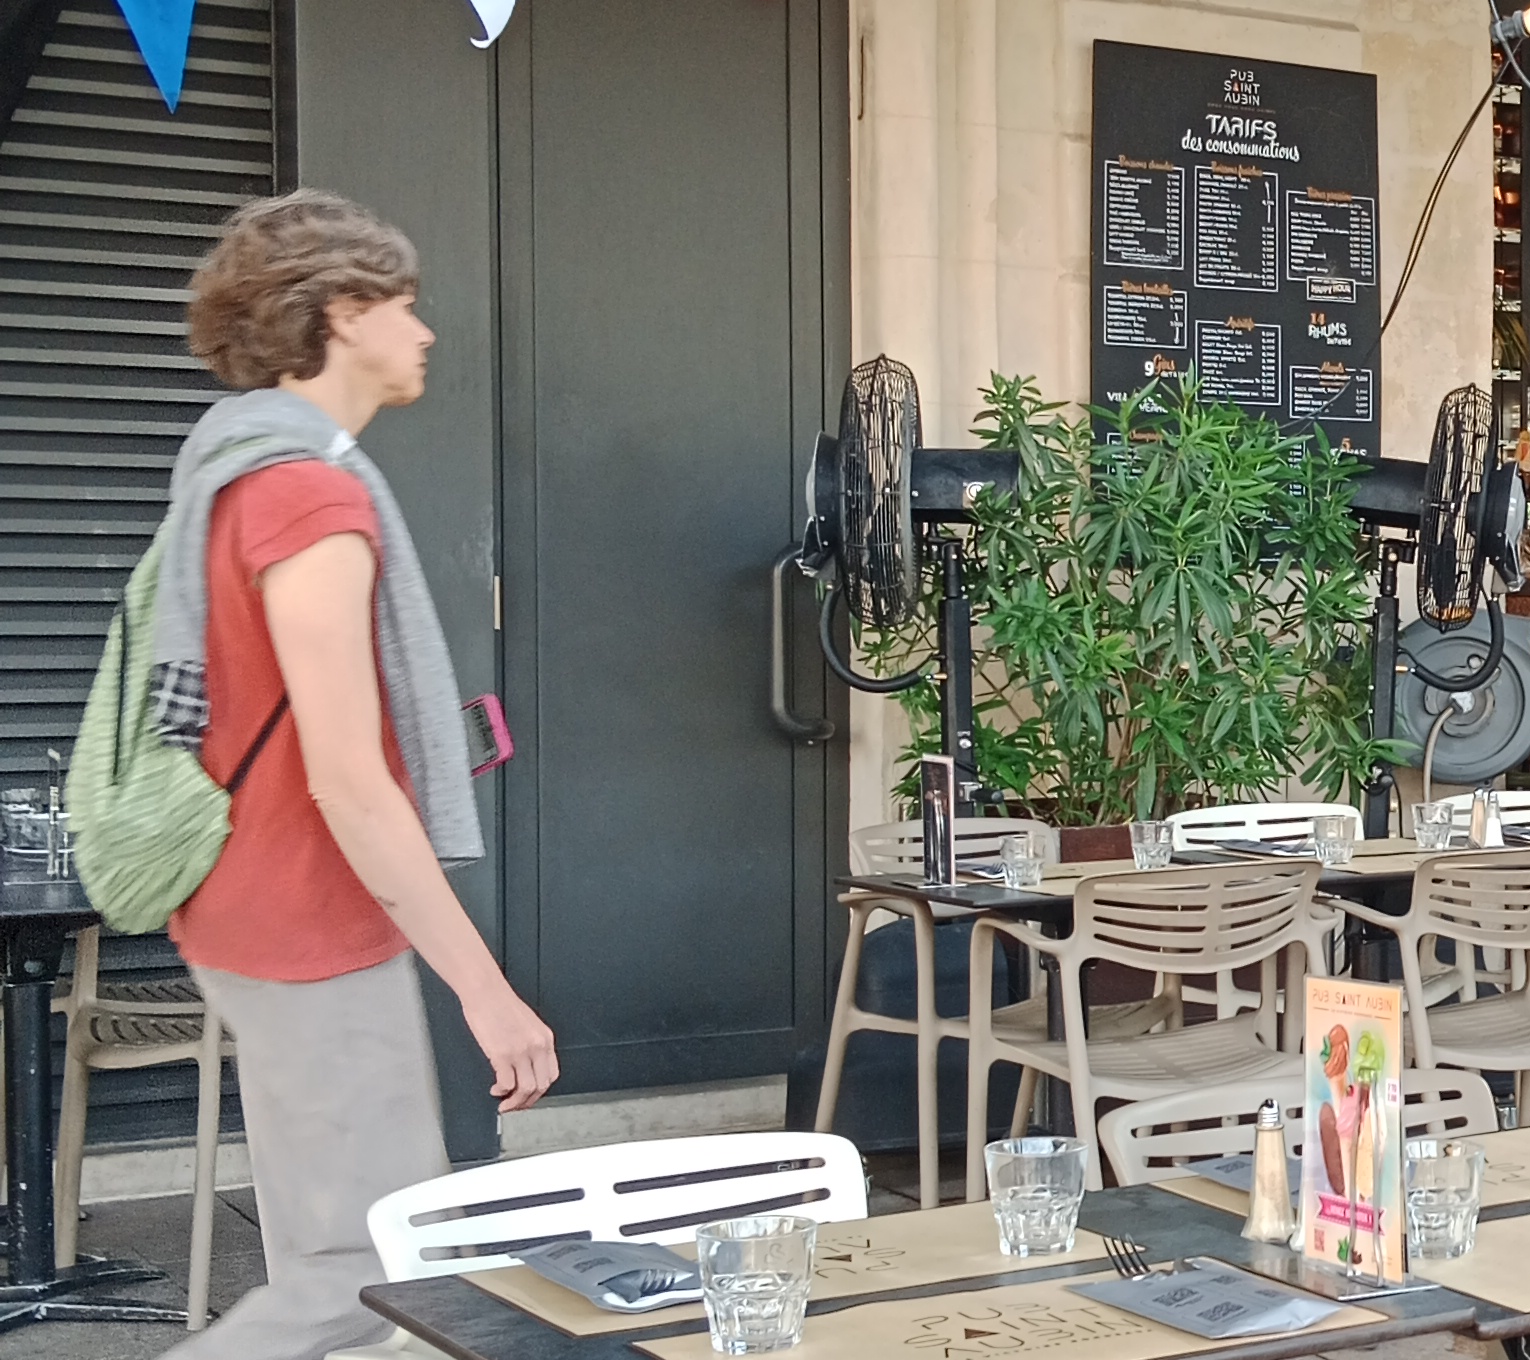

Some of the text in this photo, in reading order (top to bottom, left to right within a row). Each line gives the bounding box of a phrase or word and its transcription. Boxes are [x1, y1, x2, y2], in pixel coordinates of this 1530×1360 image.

[1230, 69, 1254, 82] PUB
[1224, 80, 1260, 94] SAINT
[1224, 93, 1260, 106] AUBIN
[1205, 114, 1278, 141] TARIFS
[1181, 128, 1300, 162] des consommations
[1308, 322, 1347, 338] RHUMS
[1144, 360, 1154, 377] 9
[1313, 988, 1393, 1012] PUB SAINT AUBIN
[911, 1302, 1051, 1331] PUB
